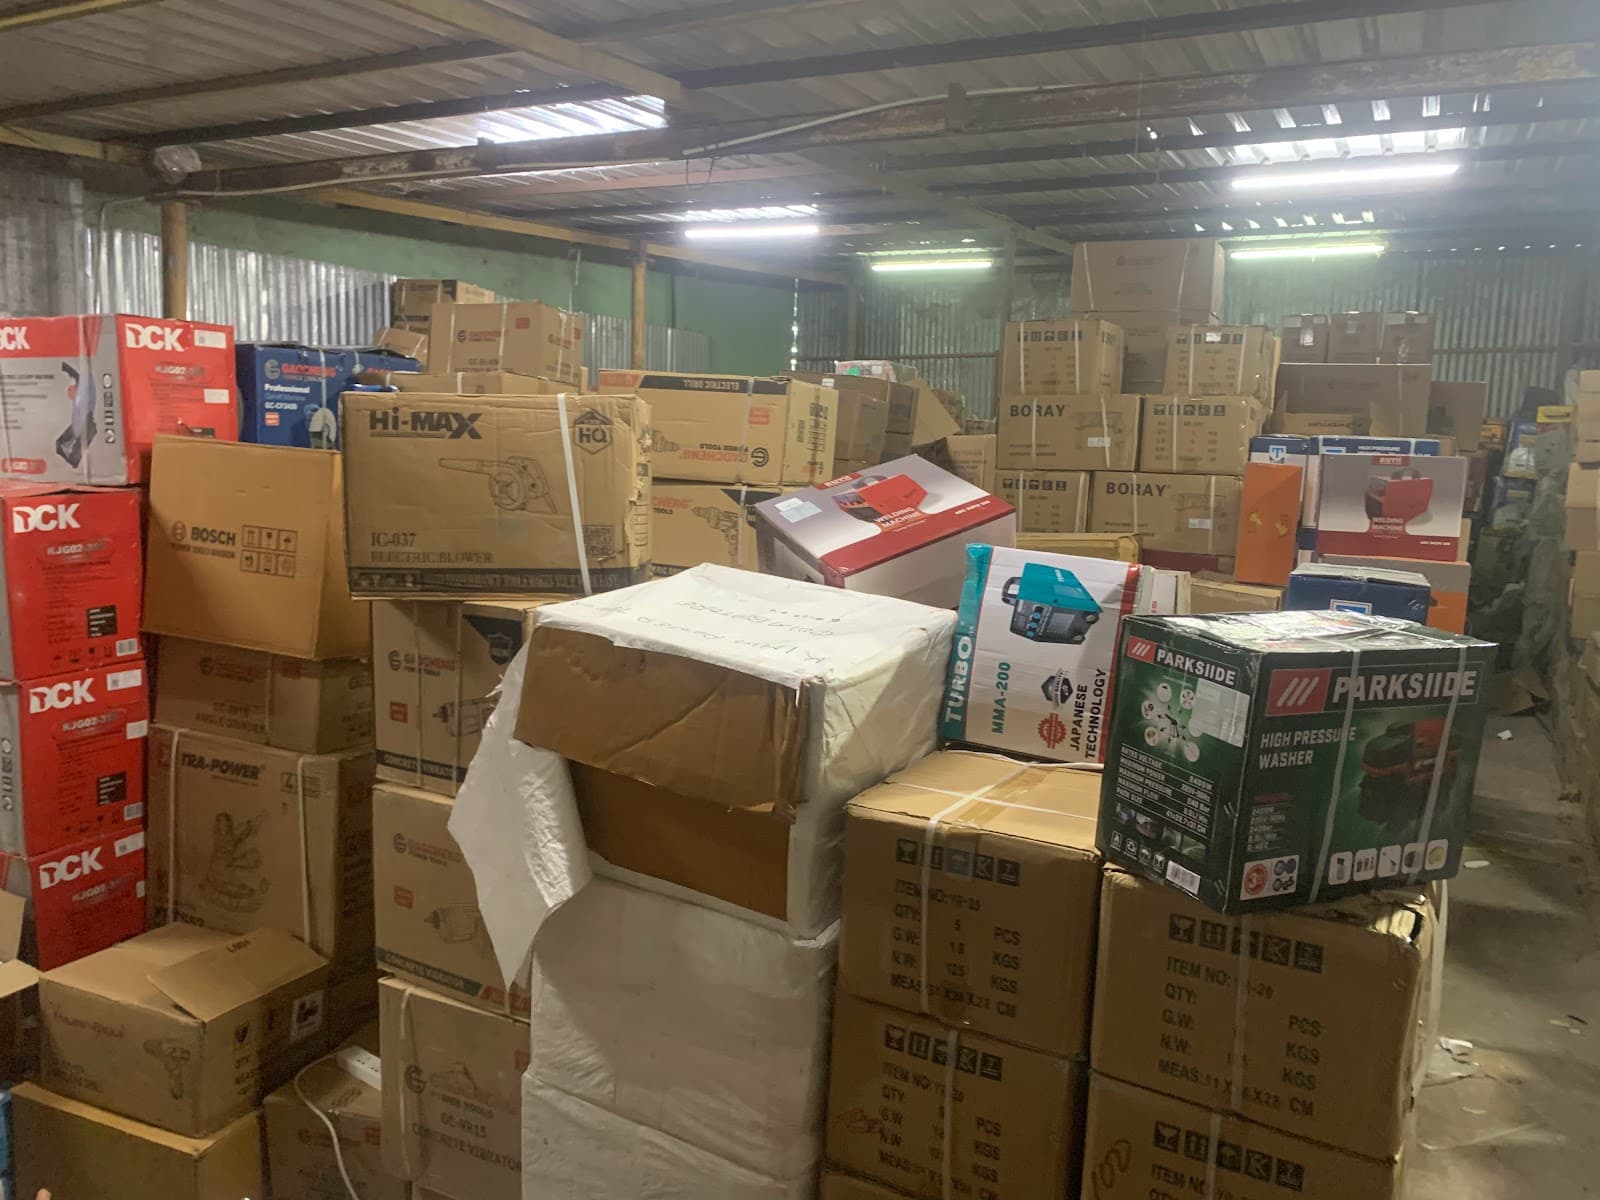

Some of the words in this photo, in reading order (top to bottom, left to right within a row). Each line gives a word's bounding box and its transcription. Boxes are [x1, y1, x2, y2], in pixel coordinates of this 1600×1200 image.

[125, 323, 184, 352] DCK
[1009, 404, 1066, 418] BORAY
[369, 408, 483, 440] Hi-MAX
[578, 427, 608, 444] HQ
[1105, 481, 1167, 498] BORAY
[12, 503, 80, 534] DCK
[873, 506, 916, 524] WELDING
[190, 526, 237, 547] BOSCH
[946, 635, 974, 723] TURBO
[29, 677, 96, 714] DCK
[991, 661, 1012, 734] MMA-200
[1070, 684, 1088, 752] JAPANESE
[1085, 668, 1108, 760] TECHNOLOGY
[1260, 732, 1291, 749] HIGH
[1259, 750, 1314, 770] WASHER
[39, 845, 103, 890] DCK
[993, 926, 1022, 947] PCS
[991, 951, 1021, 971] KGS
[1166, 955, 1202, 978] ITEM
[989, 974, 1019, 994] KGS
[1287, 1014, 1323, 1039] PCS
[1284, 1041, 1321, 1066] KGS
[1281, 1066, 1319, 1092] KGS
[1289, 1097, 1315, 1117] CM
[976, 1115, 1002, 1138] PCS
[1150, 1162, 1186, 1188] ITEM
